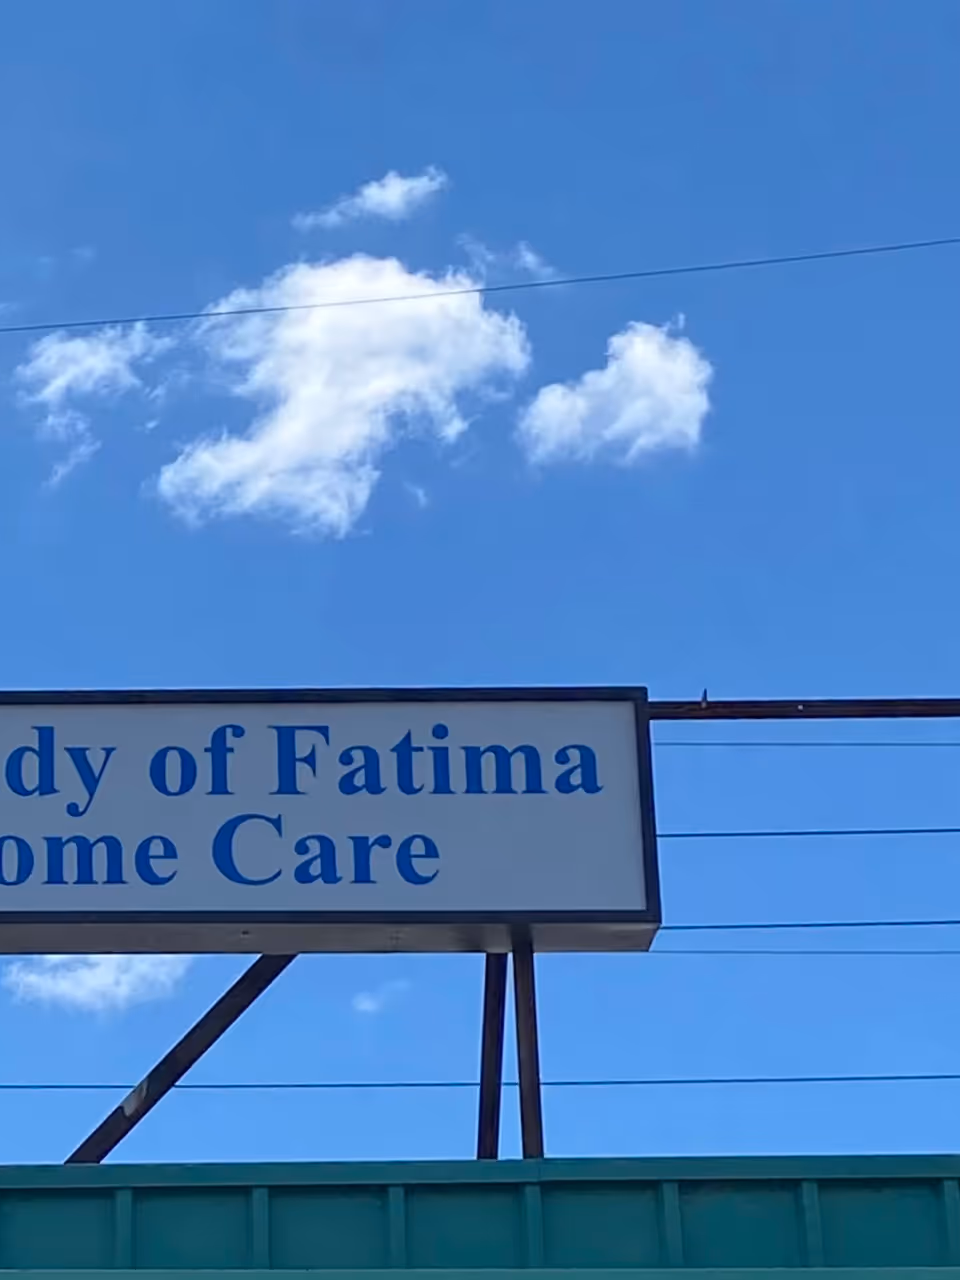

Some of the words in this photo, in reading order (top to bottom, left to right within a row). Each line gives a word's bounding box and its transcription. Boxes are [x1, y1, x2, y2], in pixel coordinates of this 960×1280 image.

[149, 724, 245, 796] of
[268, 723, 604, 796] Fatima
[212, 813, 440, 885] Care
